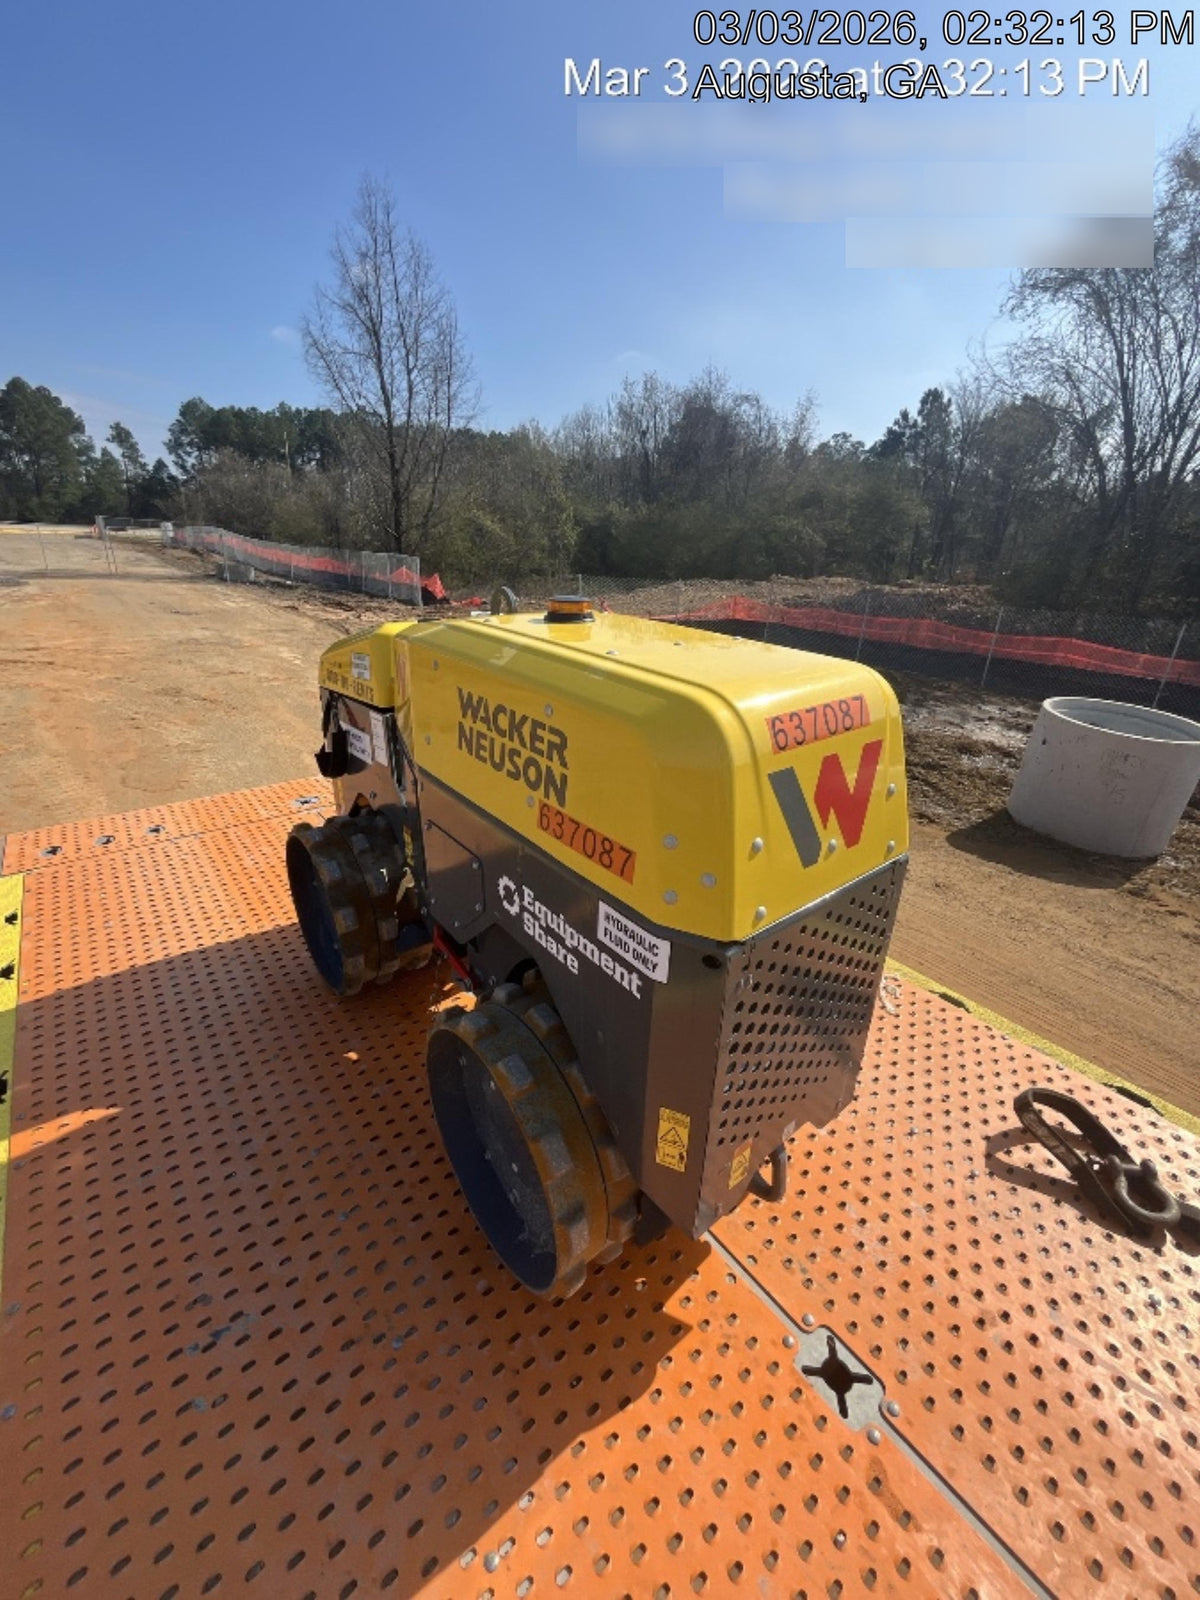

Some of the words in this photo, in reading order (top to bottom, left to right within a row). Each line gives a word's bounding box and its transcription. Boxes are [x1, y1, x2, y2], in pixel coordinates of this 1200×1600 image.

[456, 686, 569, 769] WACKER
[770, 696, 867, 751] 637087
[457, 721, 568, 808] NEUSON
[540, 803, 632, 877] 637087
[522, 884, 643, 999] Equipment
[523, 911, 579, 975] Share
[604, 911, 660, 957] HYDRAULIC
[604, 926, 630, 954] FLUID
[632, 948, 660, 973] ONLY
